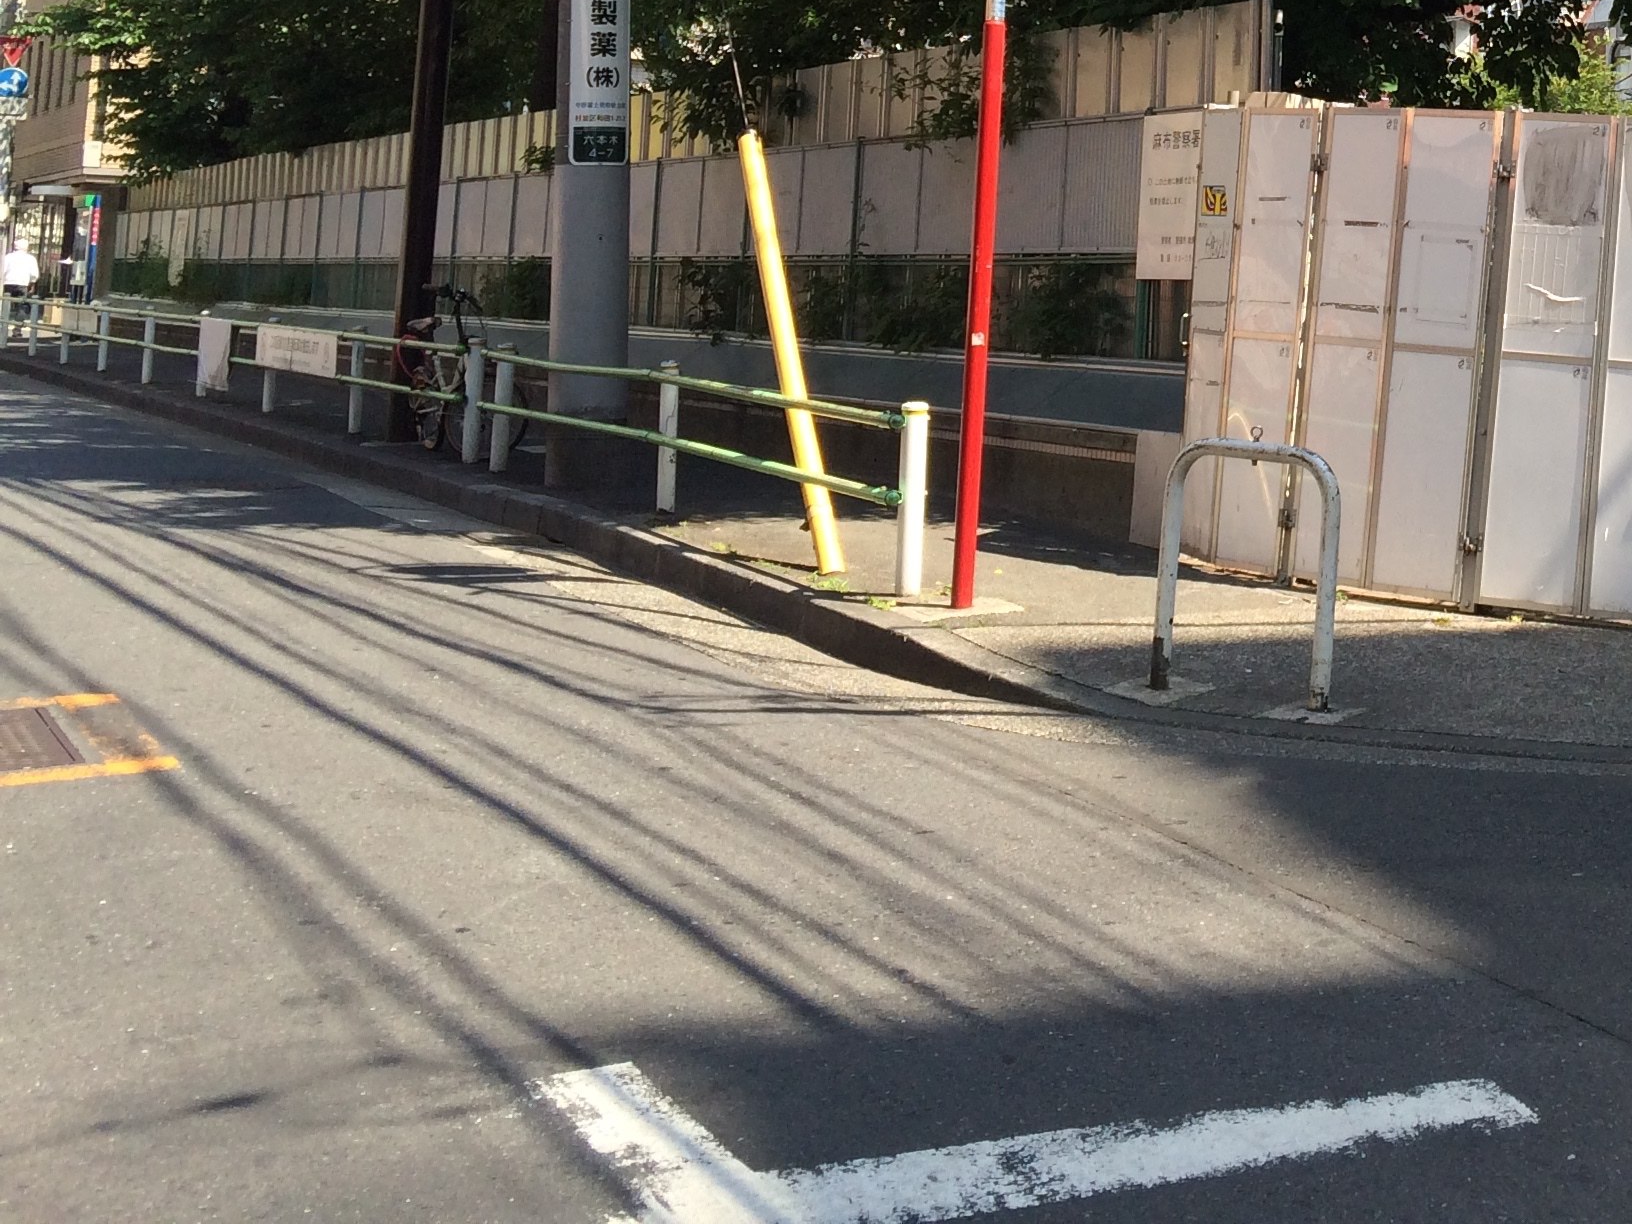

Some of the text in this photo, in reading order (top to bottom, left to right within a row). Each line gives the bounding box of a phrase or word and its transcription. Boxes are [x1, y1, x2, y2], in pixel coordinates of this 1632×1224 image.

[583, 135, 619, 146] 六本木
[1152, 129, 1201, 150] 麻布警察署
